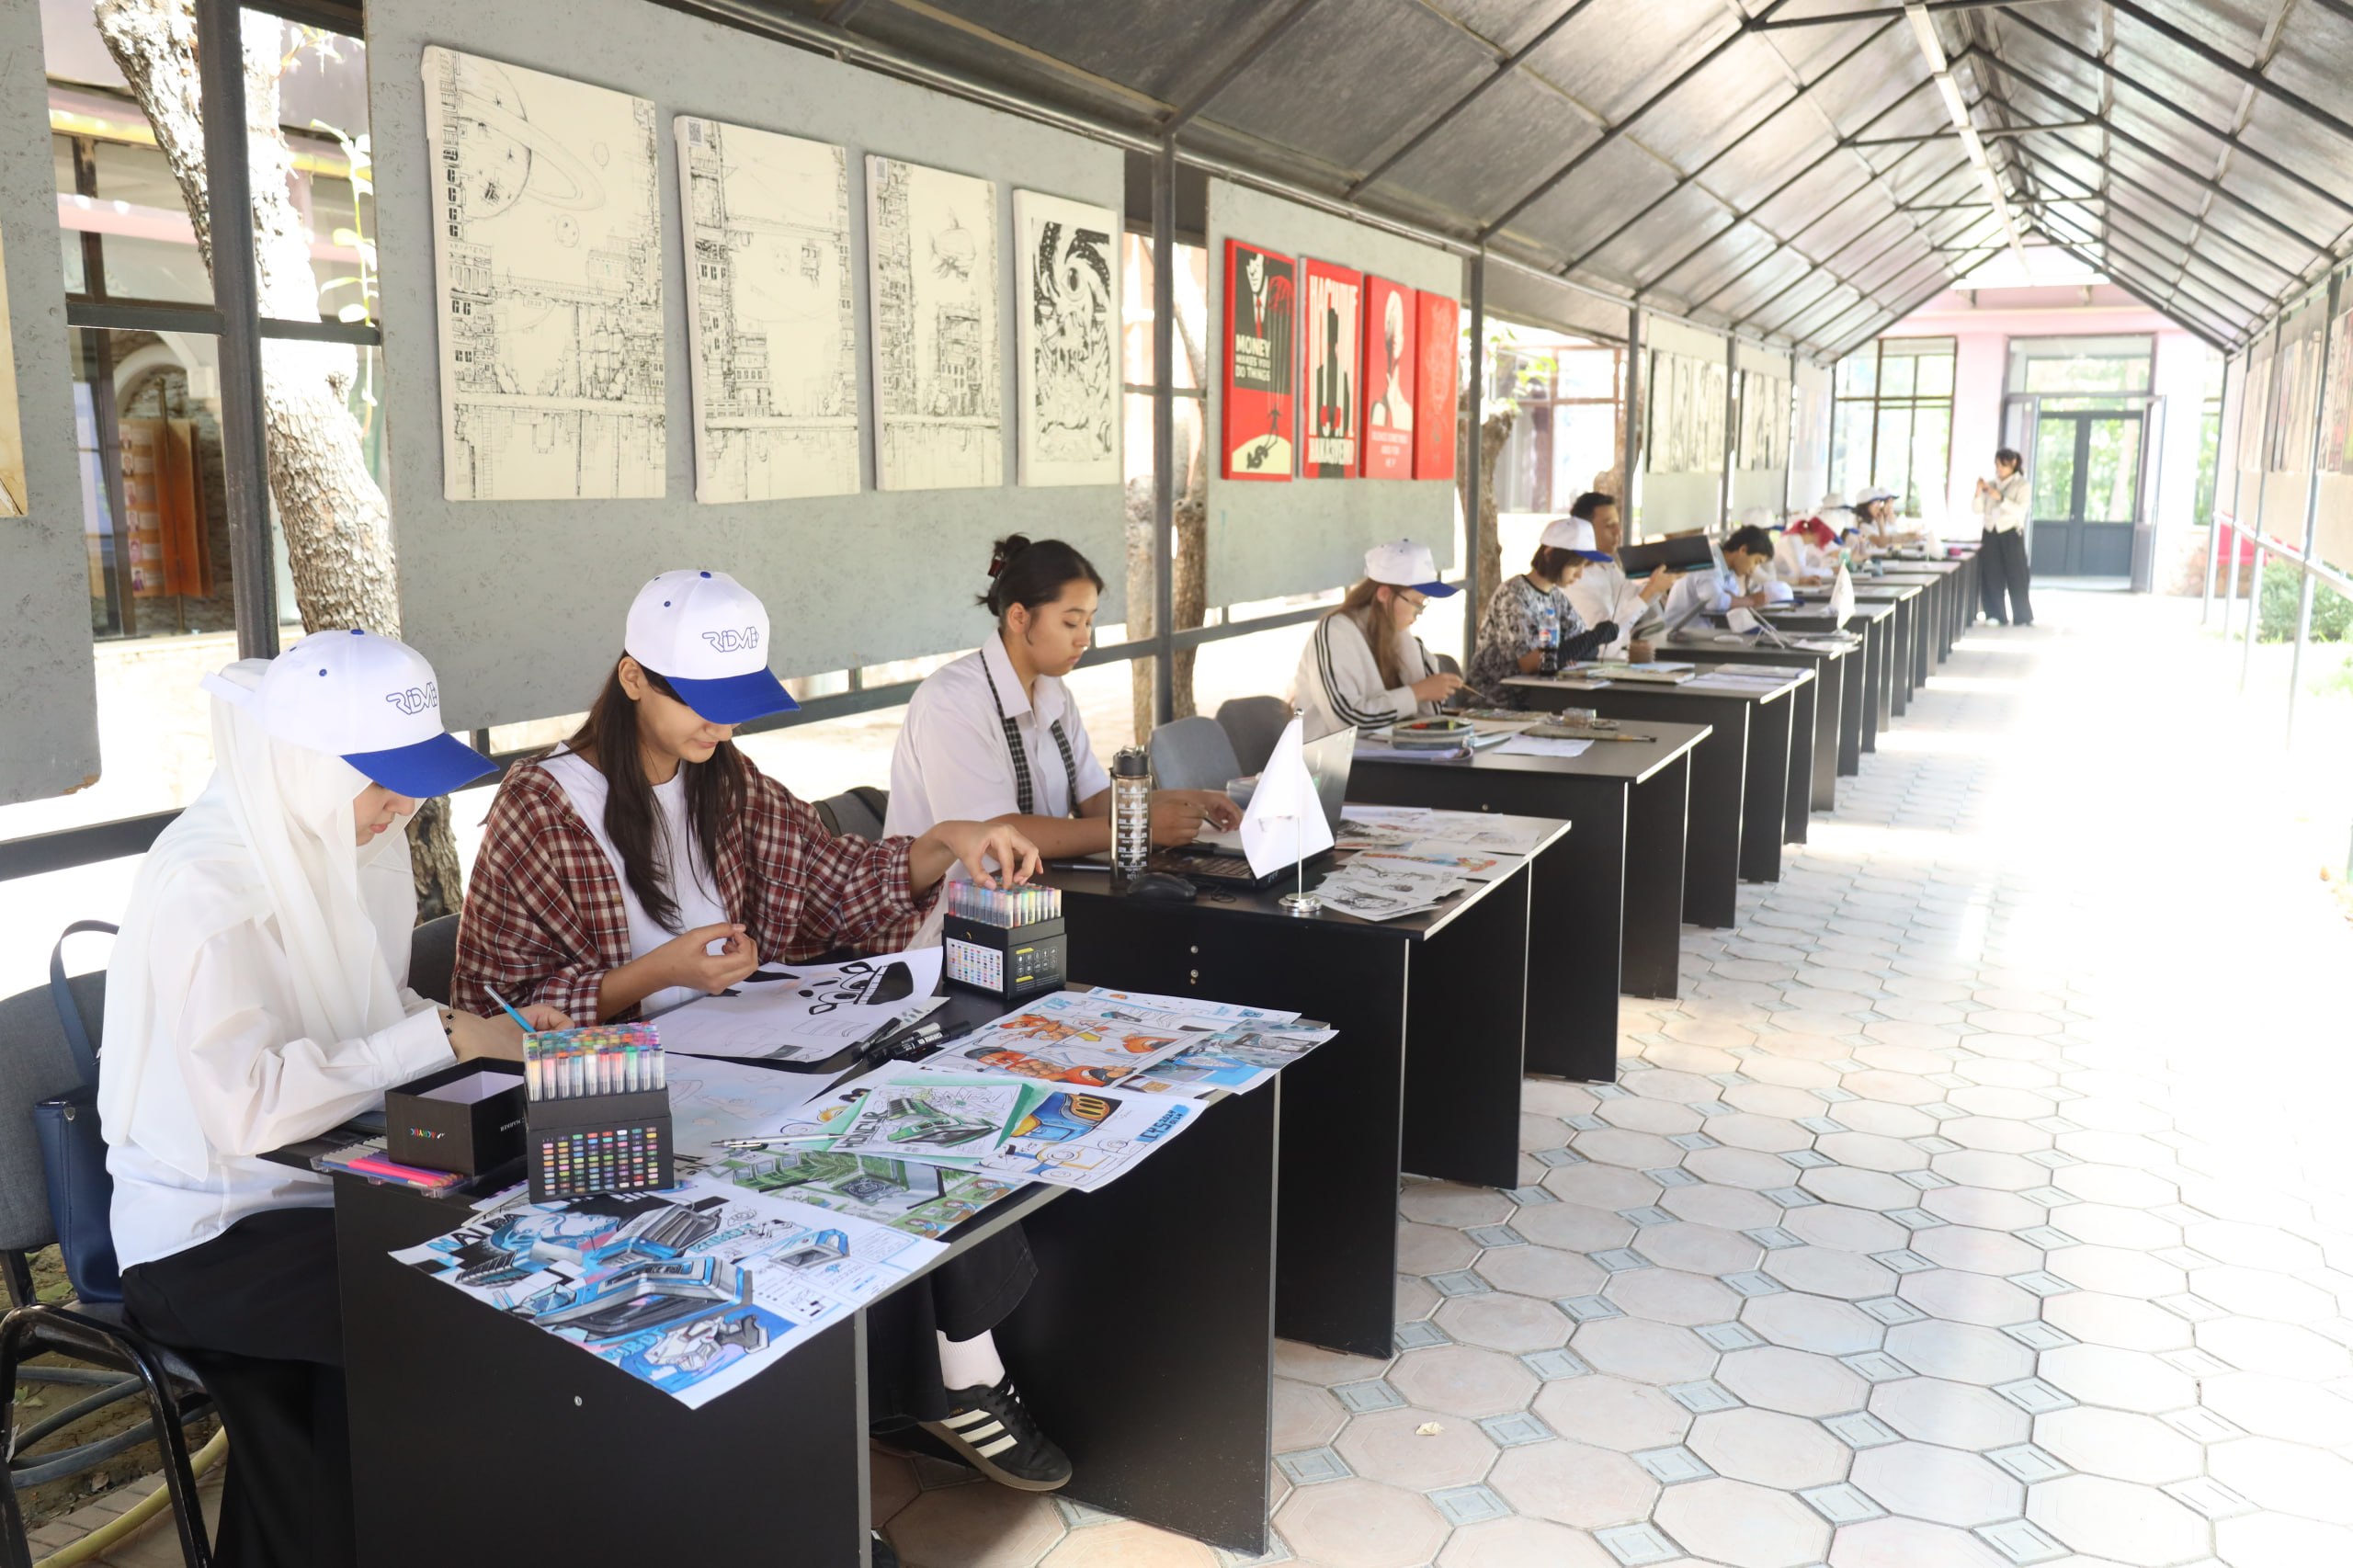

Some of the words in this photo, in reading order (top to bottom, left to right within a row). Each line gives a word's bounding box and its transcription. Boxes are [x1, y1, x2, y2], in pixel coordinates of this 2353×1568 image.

[1235, 334, 1271, 358] MONEY
[1235, 354, 1257, 367] MAKES
[1235, 365, 1246, 378] DO
[1246, 367, 1271, 381] THINGS
[410, 1127, 437, 1140] ACRYLIC
